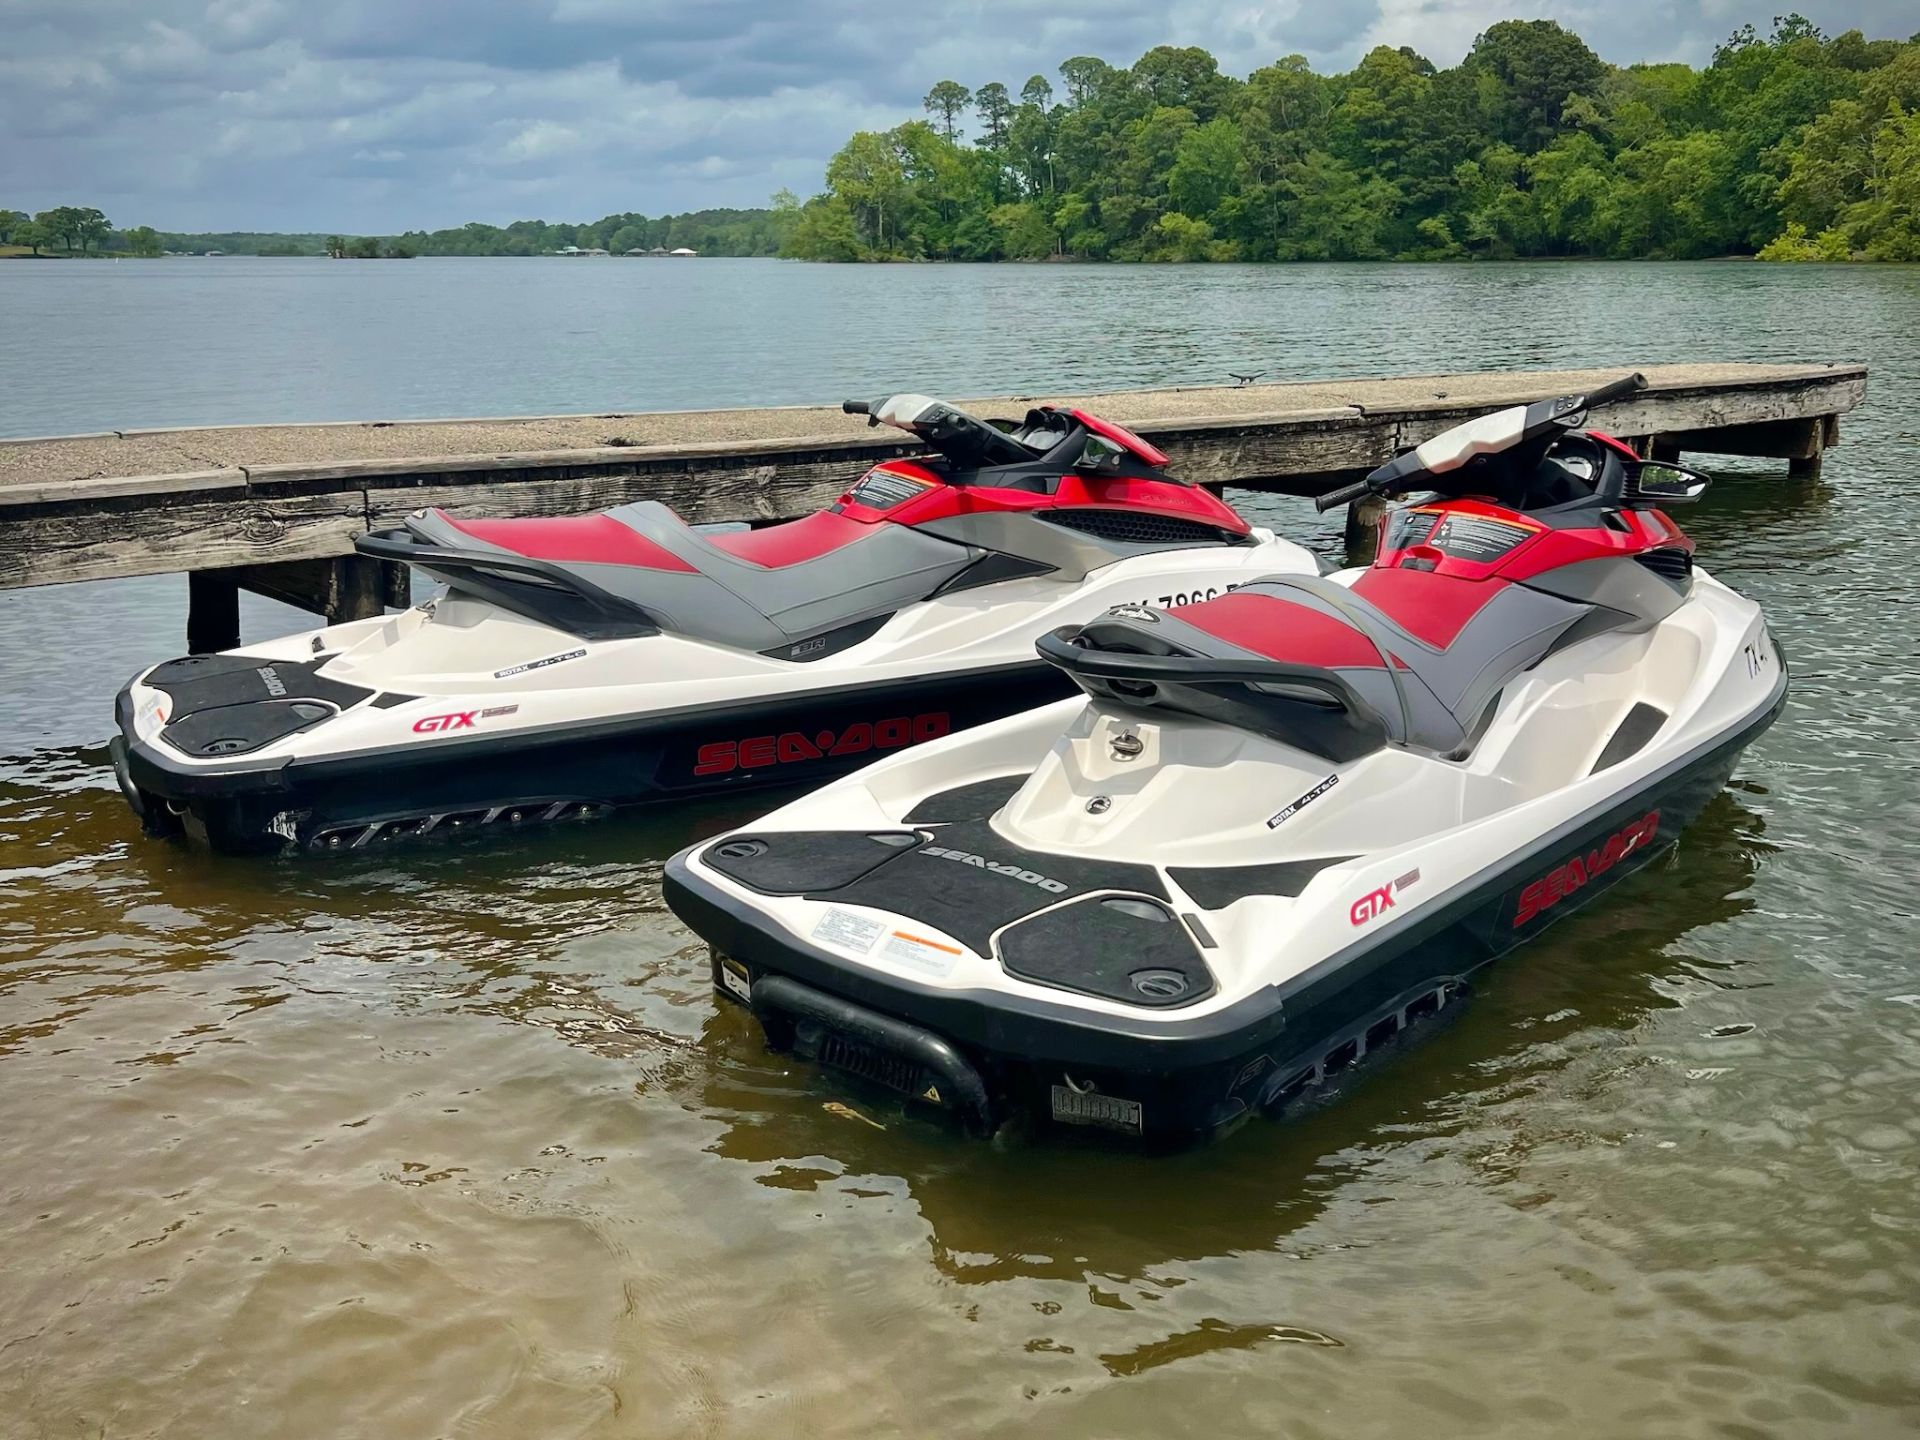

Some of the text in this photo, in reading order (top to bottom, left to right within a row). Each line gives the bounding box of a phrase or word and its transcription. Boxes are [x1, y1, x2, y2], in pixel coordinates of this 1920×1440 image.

[499, 664, 529, 677] ROTAX
[412, 709, 481, 733] GTX
[1270, 775, 1338, 827] ROTAX 4-TEC
[1350, 880, 1397, 927] GTX
